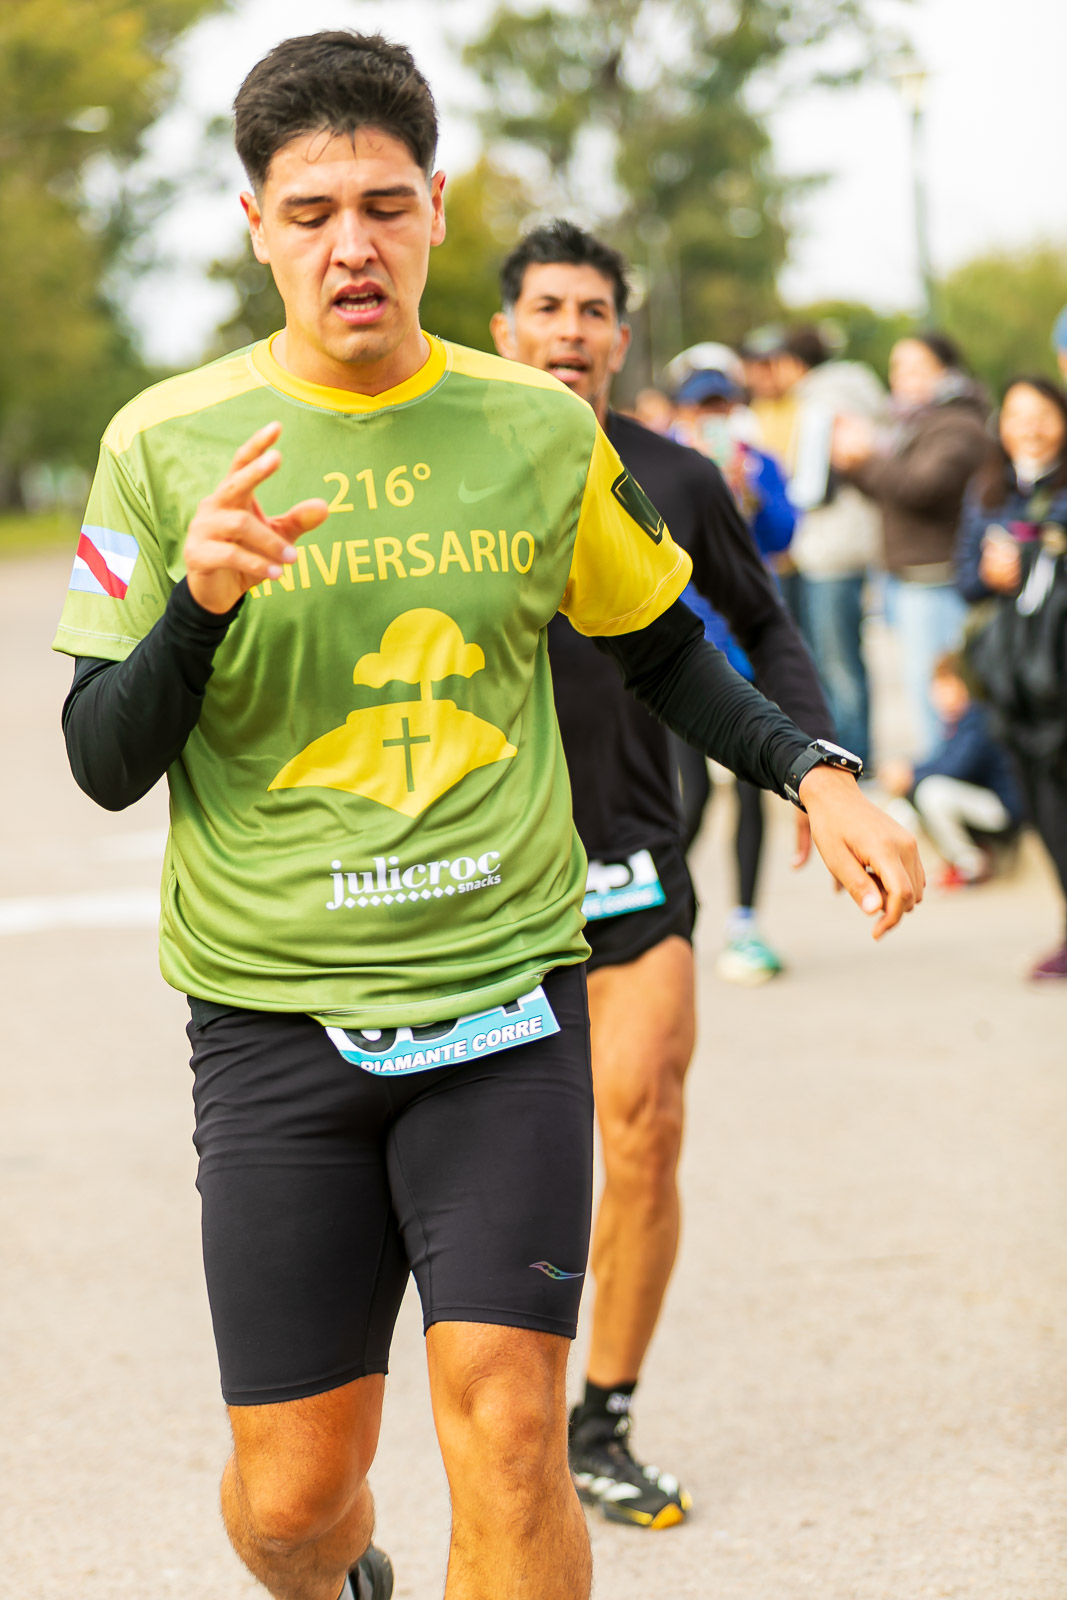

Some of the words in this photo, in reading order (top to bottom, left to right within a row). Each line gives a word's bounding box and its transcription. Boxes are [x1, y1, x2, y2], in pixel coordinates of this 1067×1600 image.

[323, 462, 432, 513] 216°
[249, 529, 535, 599] NIVERSARIO
[325, 851, 502, 910] julicroc
[457, 873, 502, 894] snacks
[360, 1040, 468, 1074] DIAMANTE
[472, 1015, 544, 1052] CORRE
